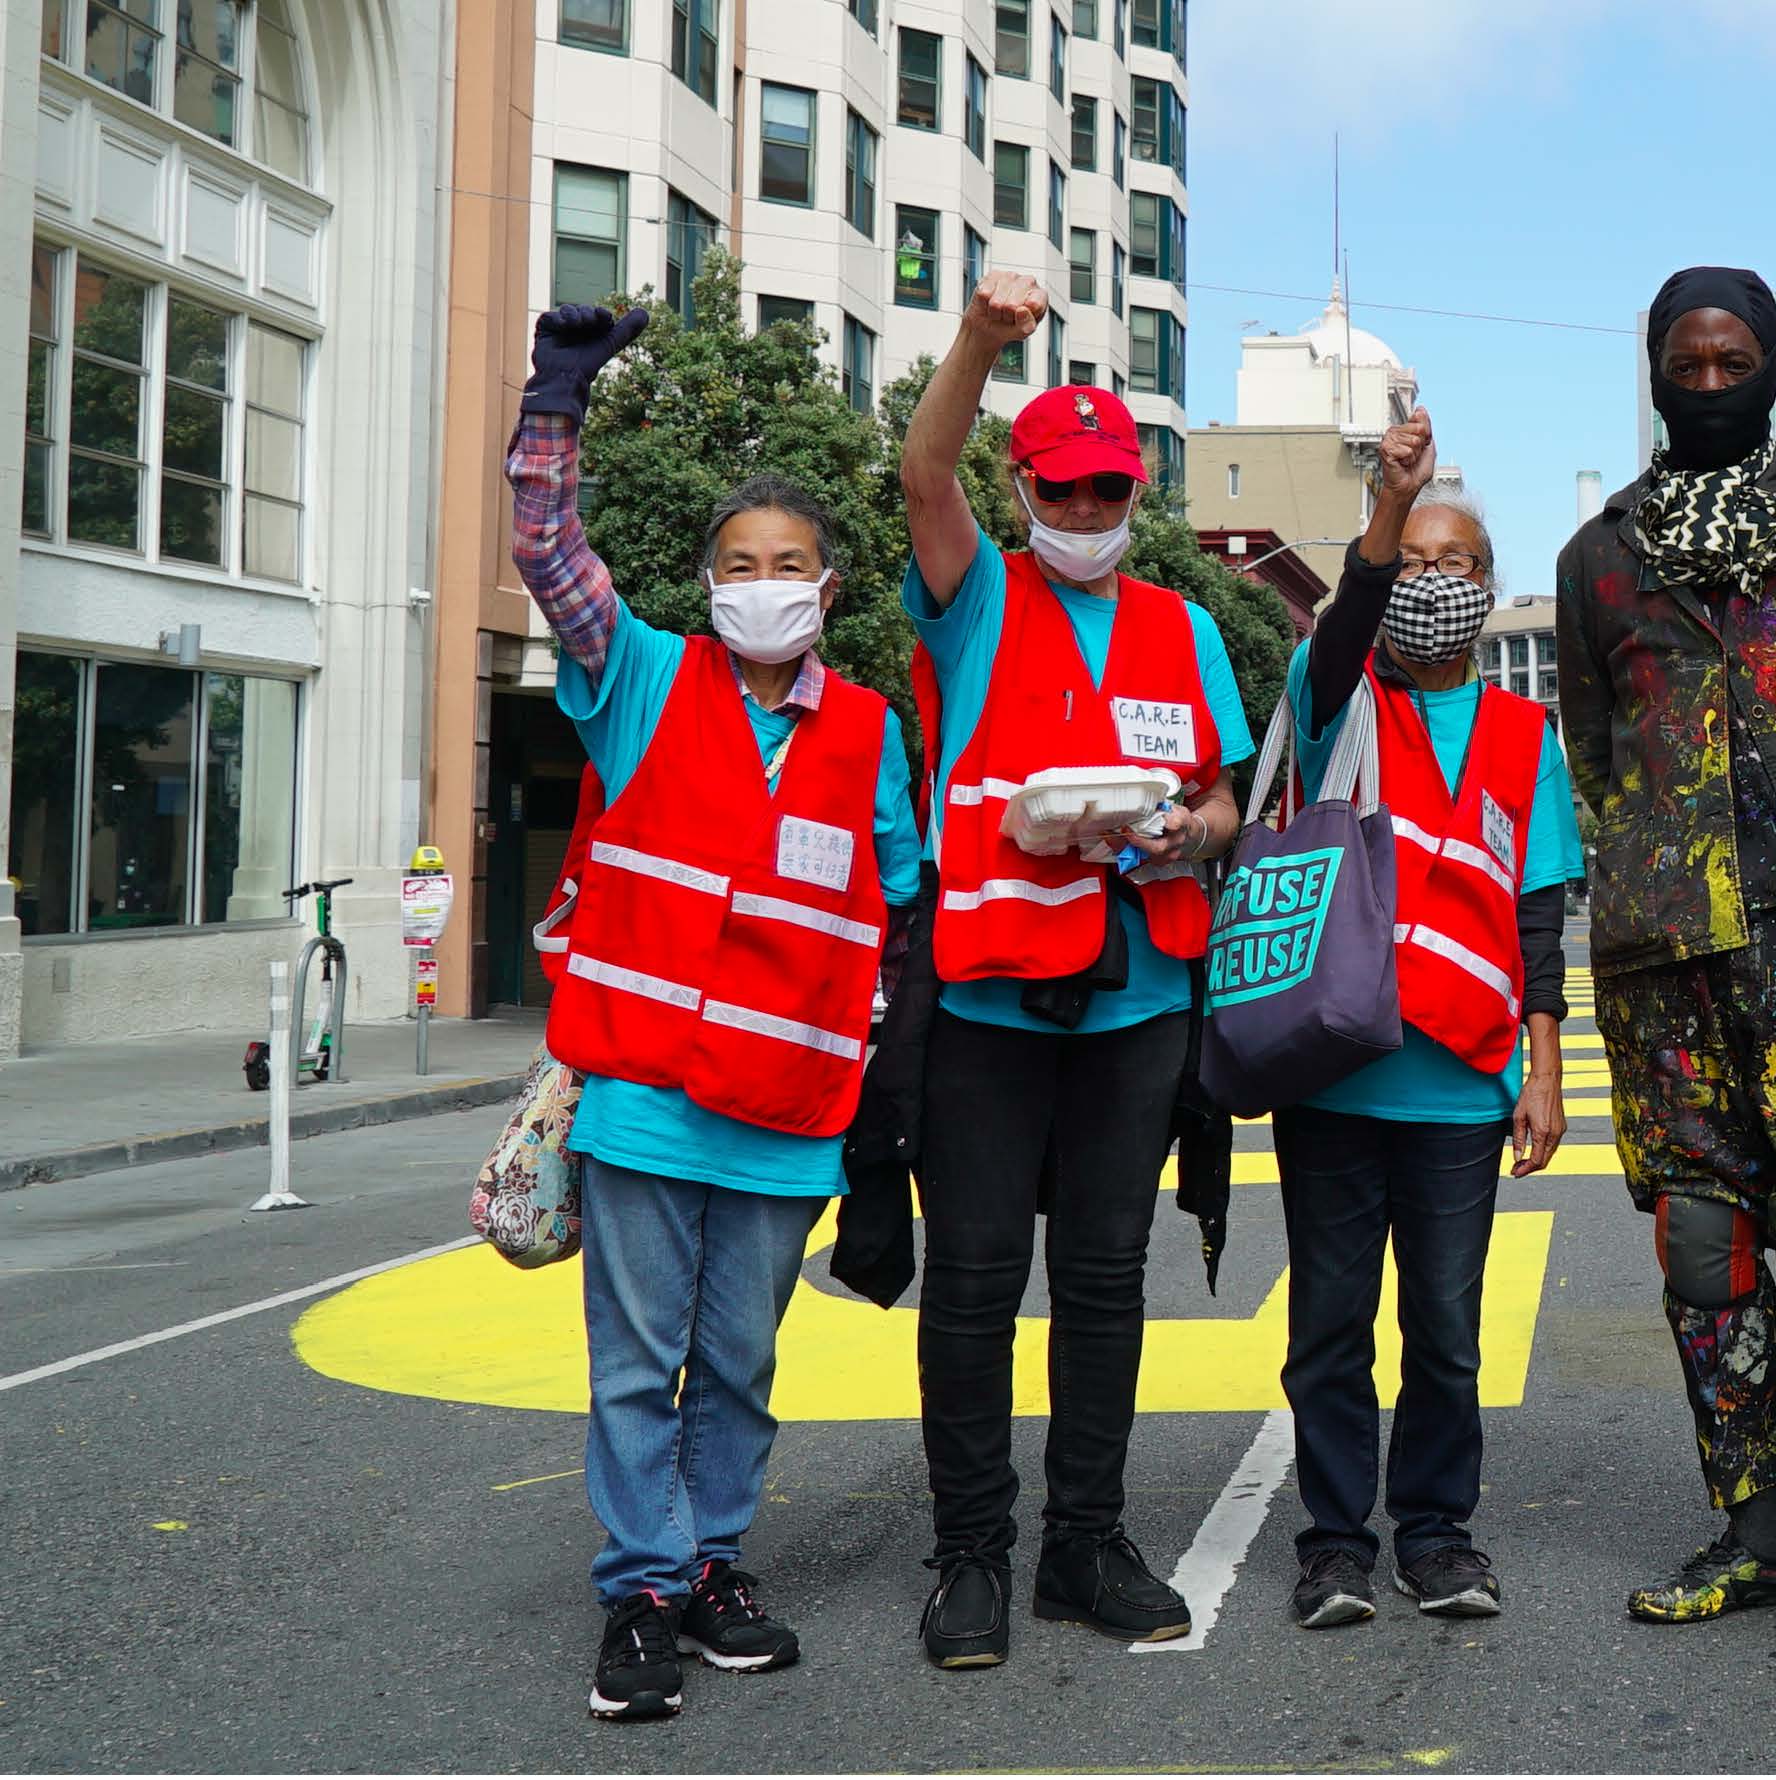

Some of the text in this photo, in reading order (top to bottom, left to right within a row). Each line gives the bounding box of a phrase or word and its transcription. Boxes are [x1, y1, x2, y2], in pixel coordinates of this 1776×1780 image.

[1119, 703, 1187, 727] C.A.R.E.
[1133, 733, 1178, 757] TEAM
[1489, 827, 1510, 864] TEAM
[1209, 925, 1312, 992] REUSE
